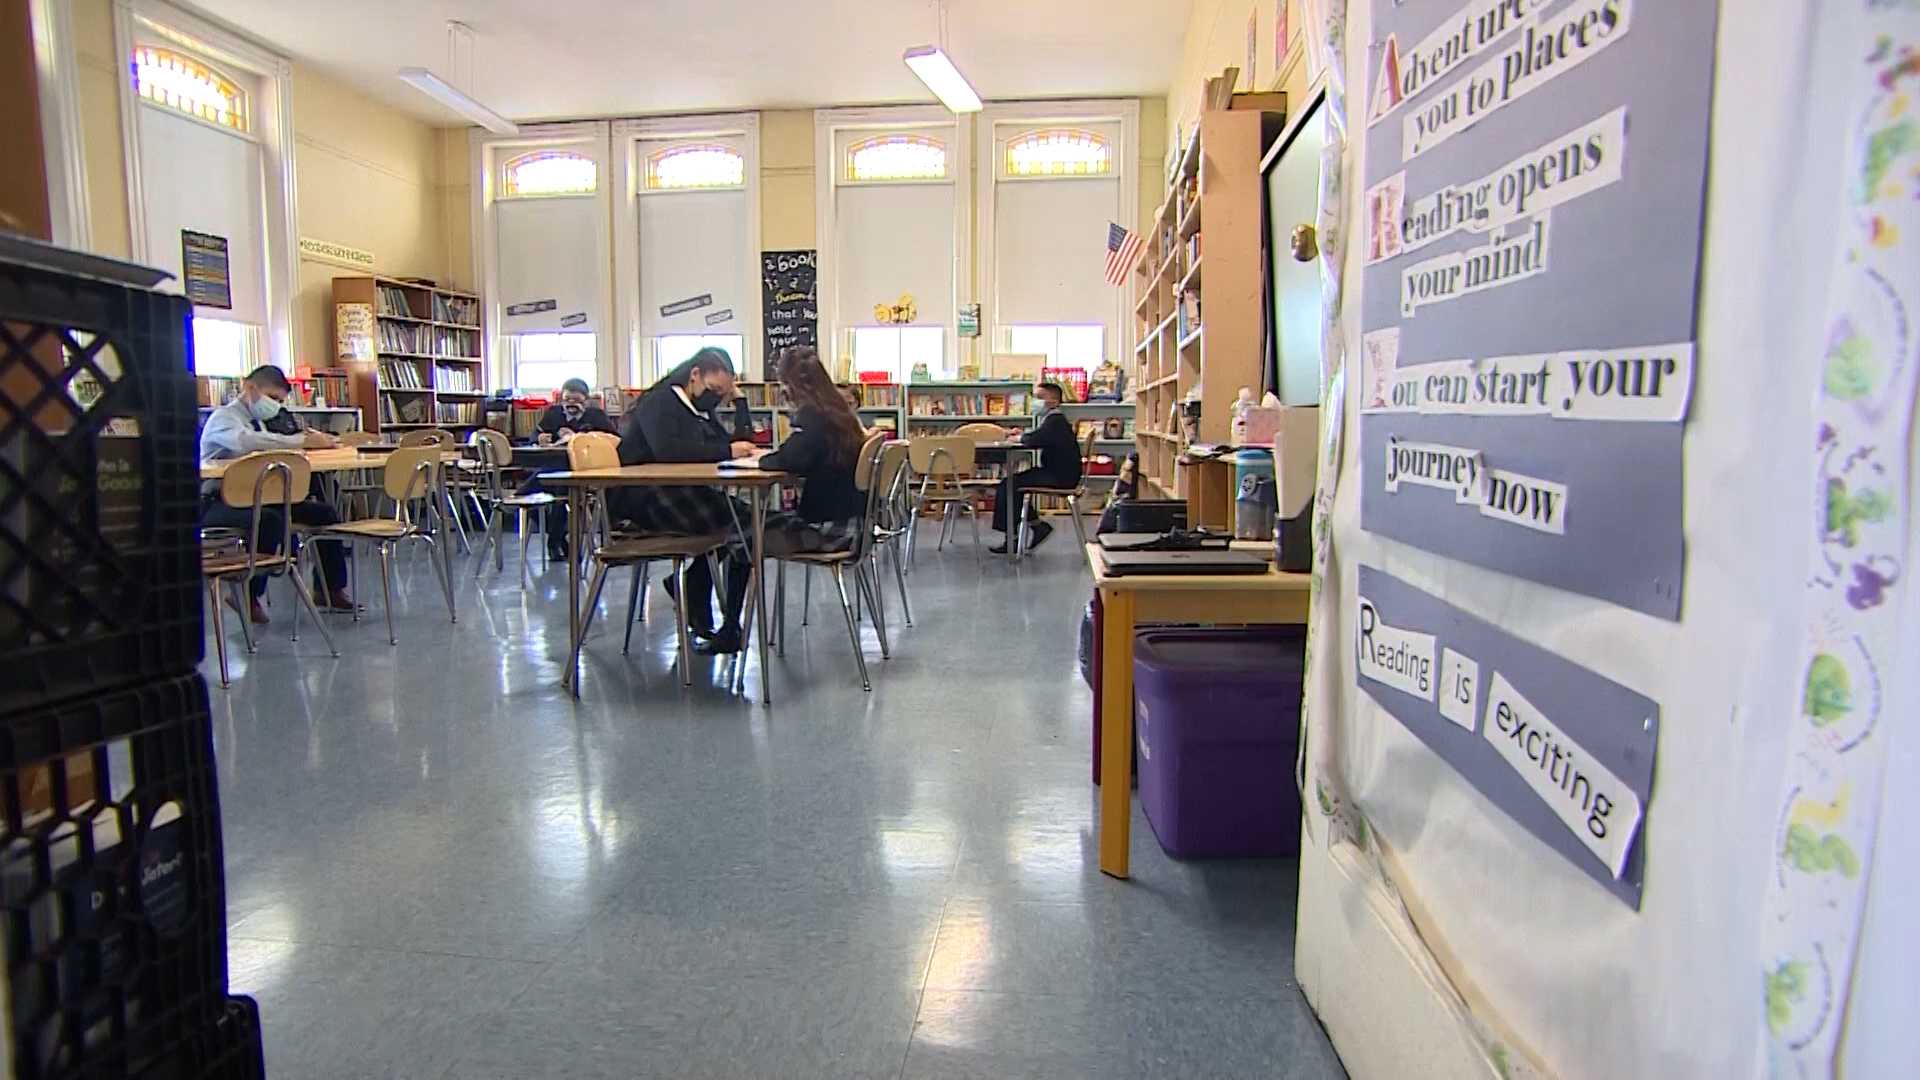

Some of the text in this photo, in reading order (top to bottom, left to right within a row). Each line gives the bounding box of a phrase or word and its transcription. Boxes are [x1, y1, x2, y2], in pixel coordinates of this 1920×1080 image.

[1374, 0, 1541, 117] Adventure
[1414, 0, 1620, 154] you to places
[1369, 132, 1605, 261] Reading opens
[771, 309, 797, 321] that
[1405, 220, 1545, 313] your mind
[1424, 373, 1468, 405] can
[1472, 359, 1553, 406] start
[1562, 354, 1676, 412] your
[1386, 434, 1562, 525] journey now
[1358, 603, 1616, 840] Reading is exciting
